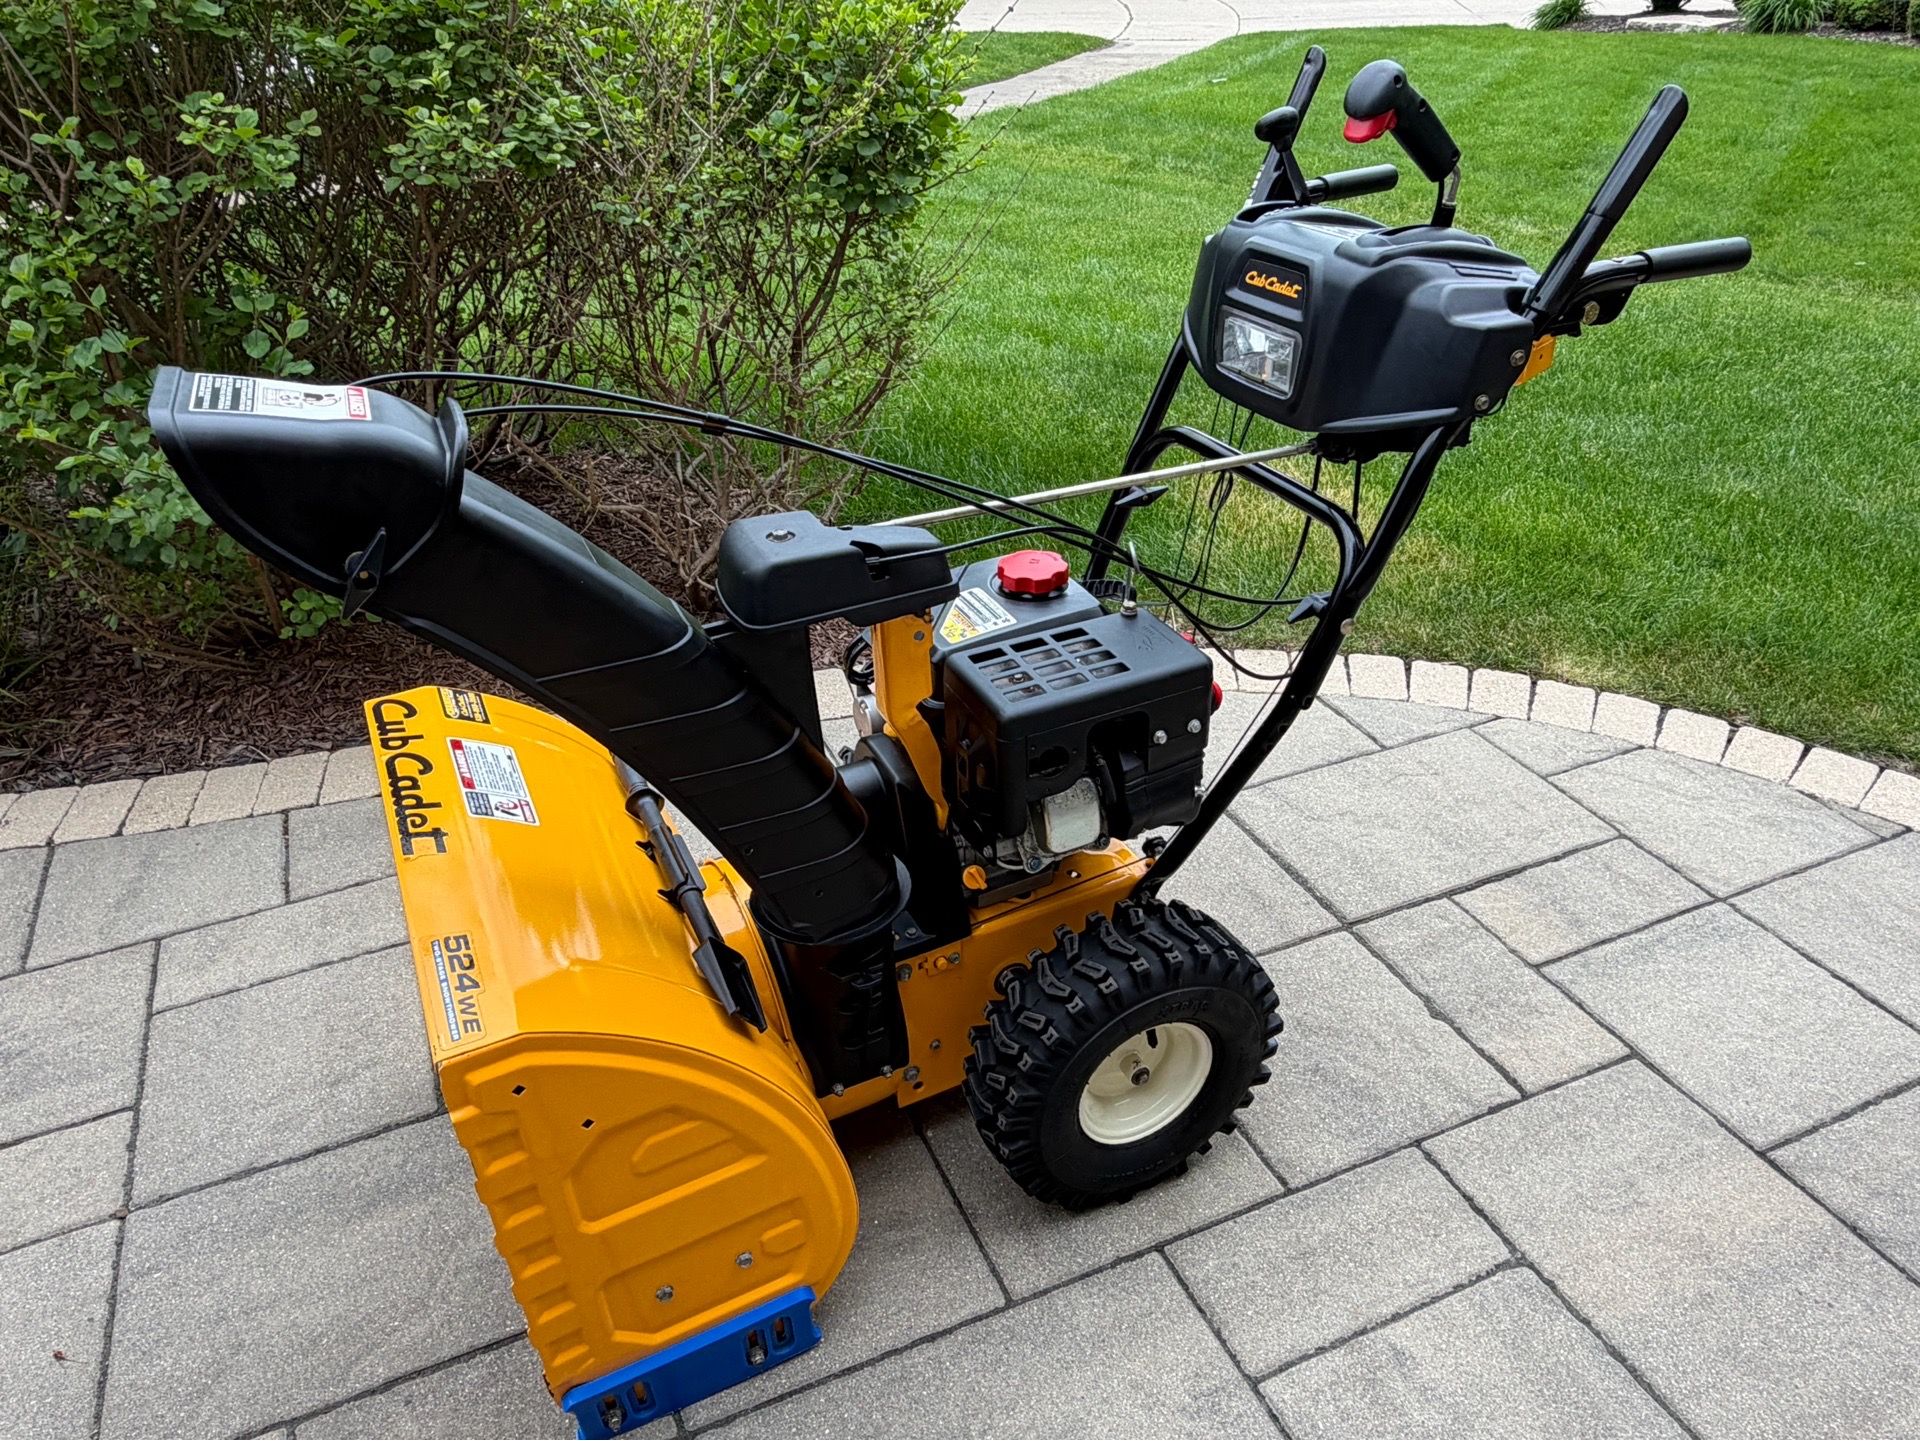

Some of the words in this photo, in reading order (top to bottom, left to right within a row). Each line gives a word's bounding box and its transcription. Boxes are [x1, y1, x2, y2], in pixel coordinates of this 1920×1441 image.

[1245, 271, 1266, 287] Cub
[1266, 277, 1302, 298] Cadet
[371, 699, 425, 751] Cub
[385, 752, 449, 856] Cadet
